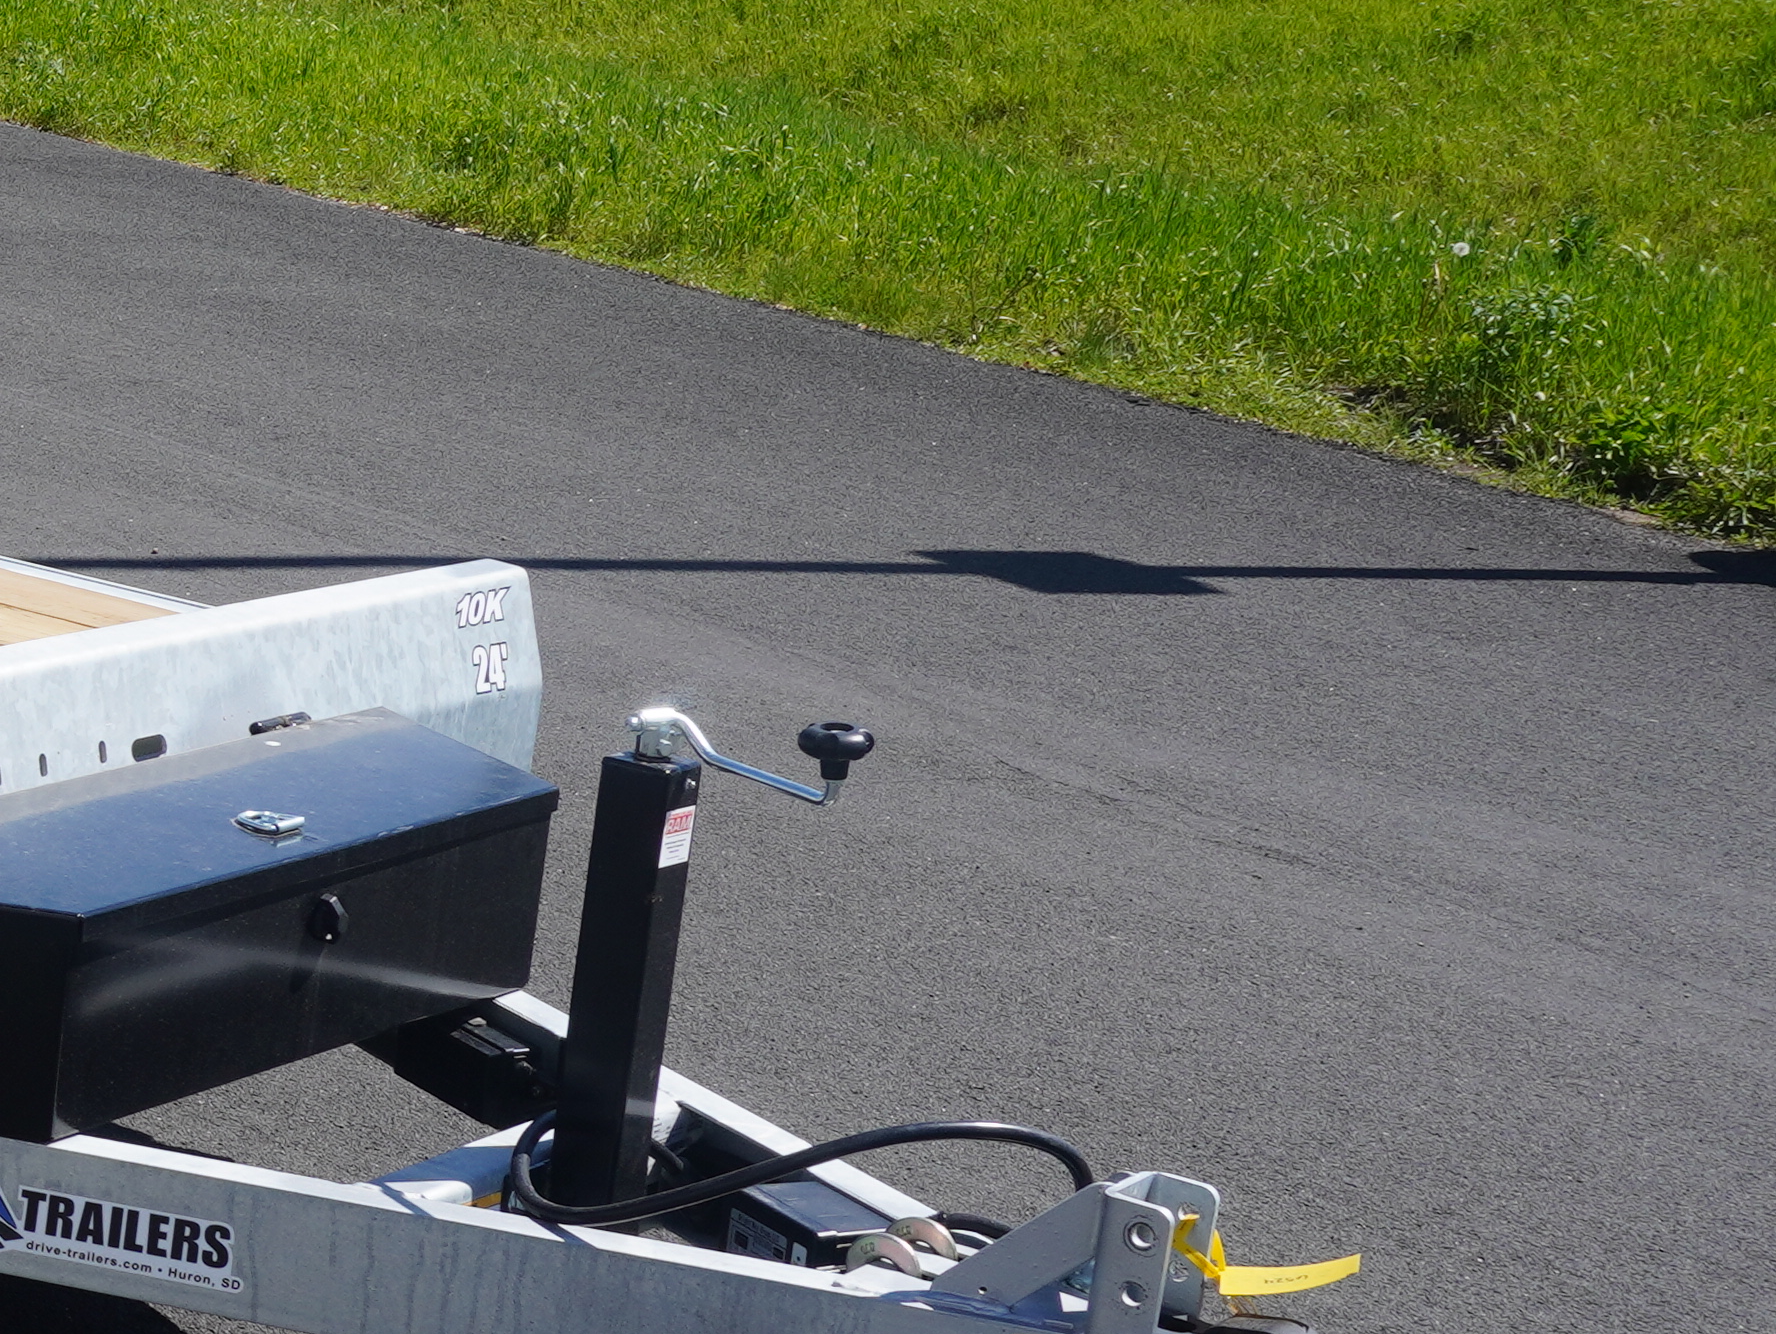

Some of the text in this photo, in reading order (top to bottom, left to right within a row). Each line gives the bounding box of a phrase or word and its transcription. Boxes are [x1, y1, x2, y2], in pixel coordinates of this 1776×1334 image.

[455, 586, 511, 629] 10K
[471, 641, 508, 695] 24'
[21, 1188, 231, 1269] TRAILERS
[26, 1240, 241, 1291] drive-trailers.com Huron, SD
